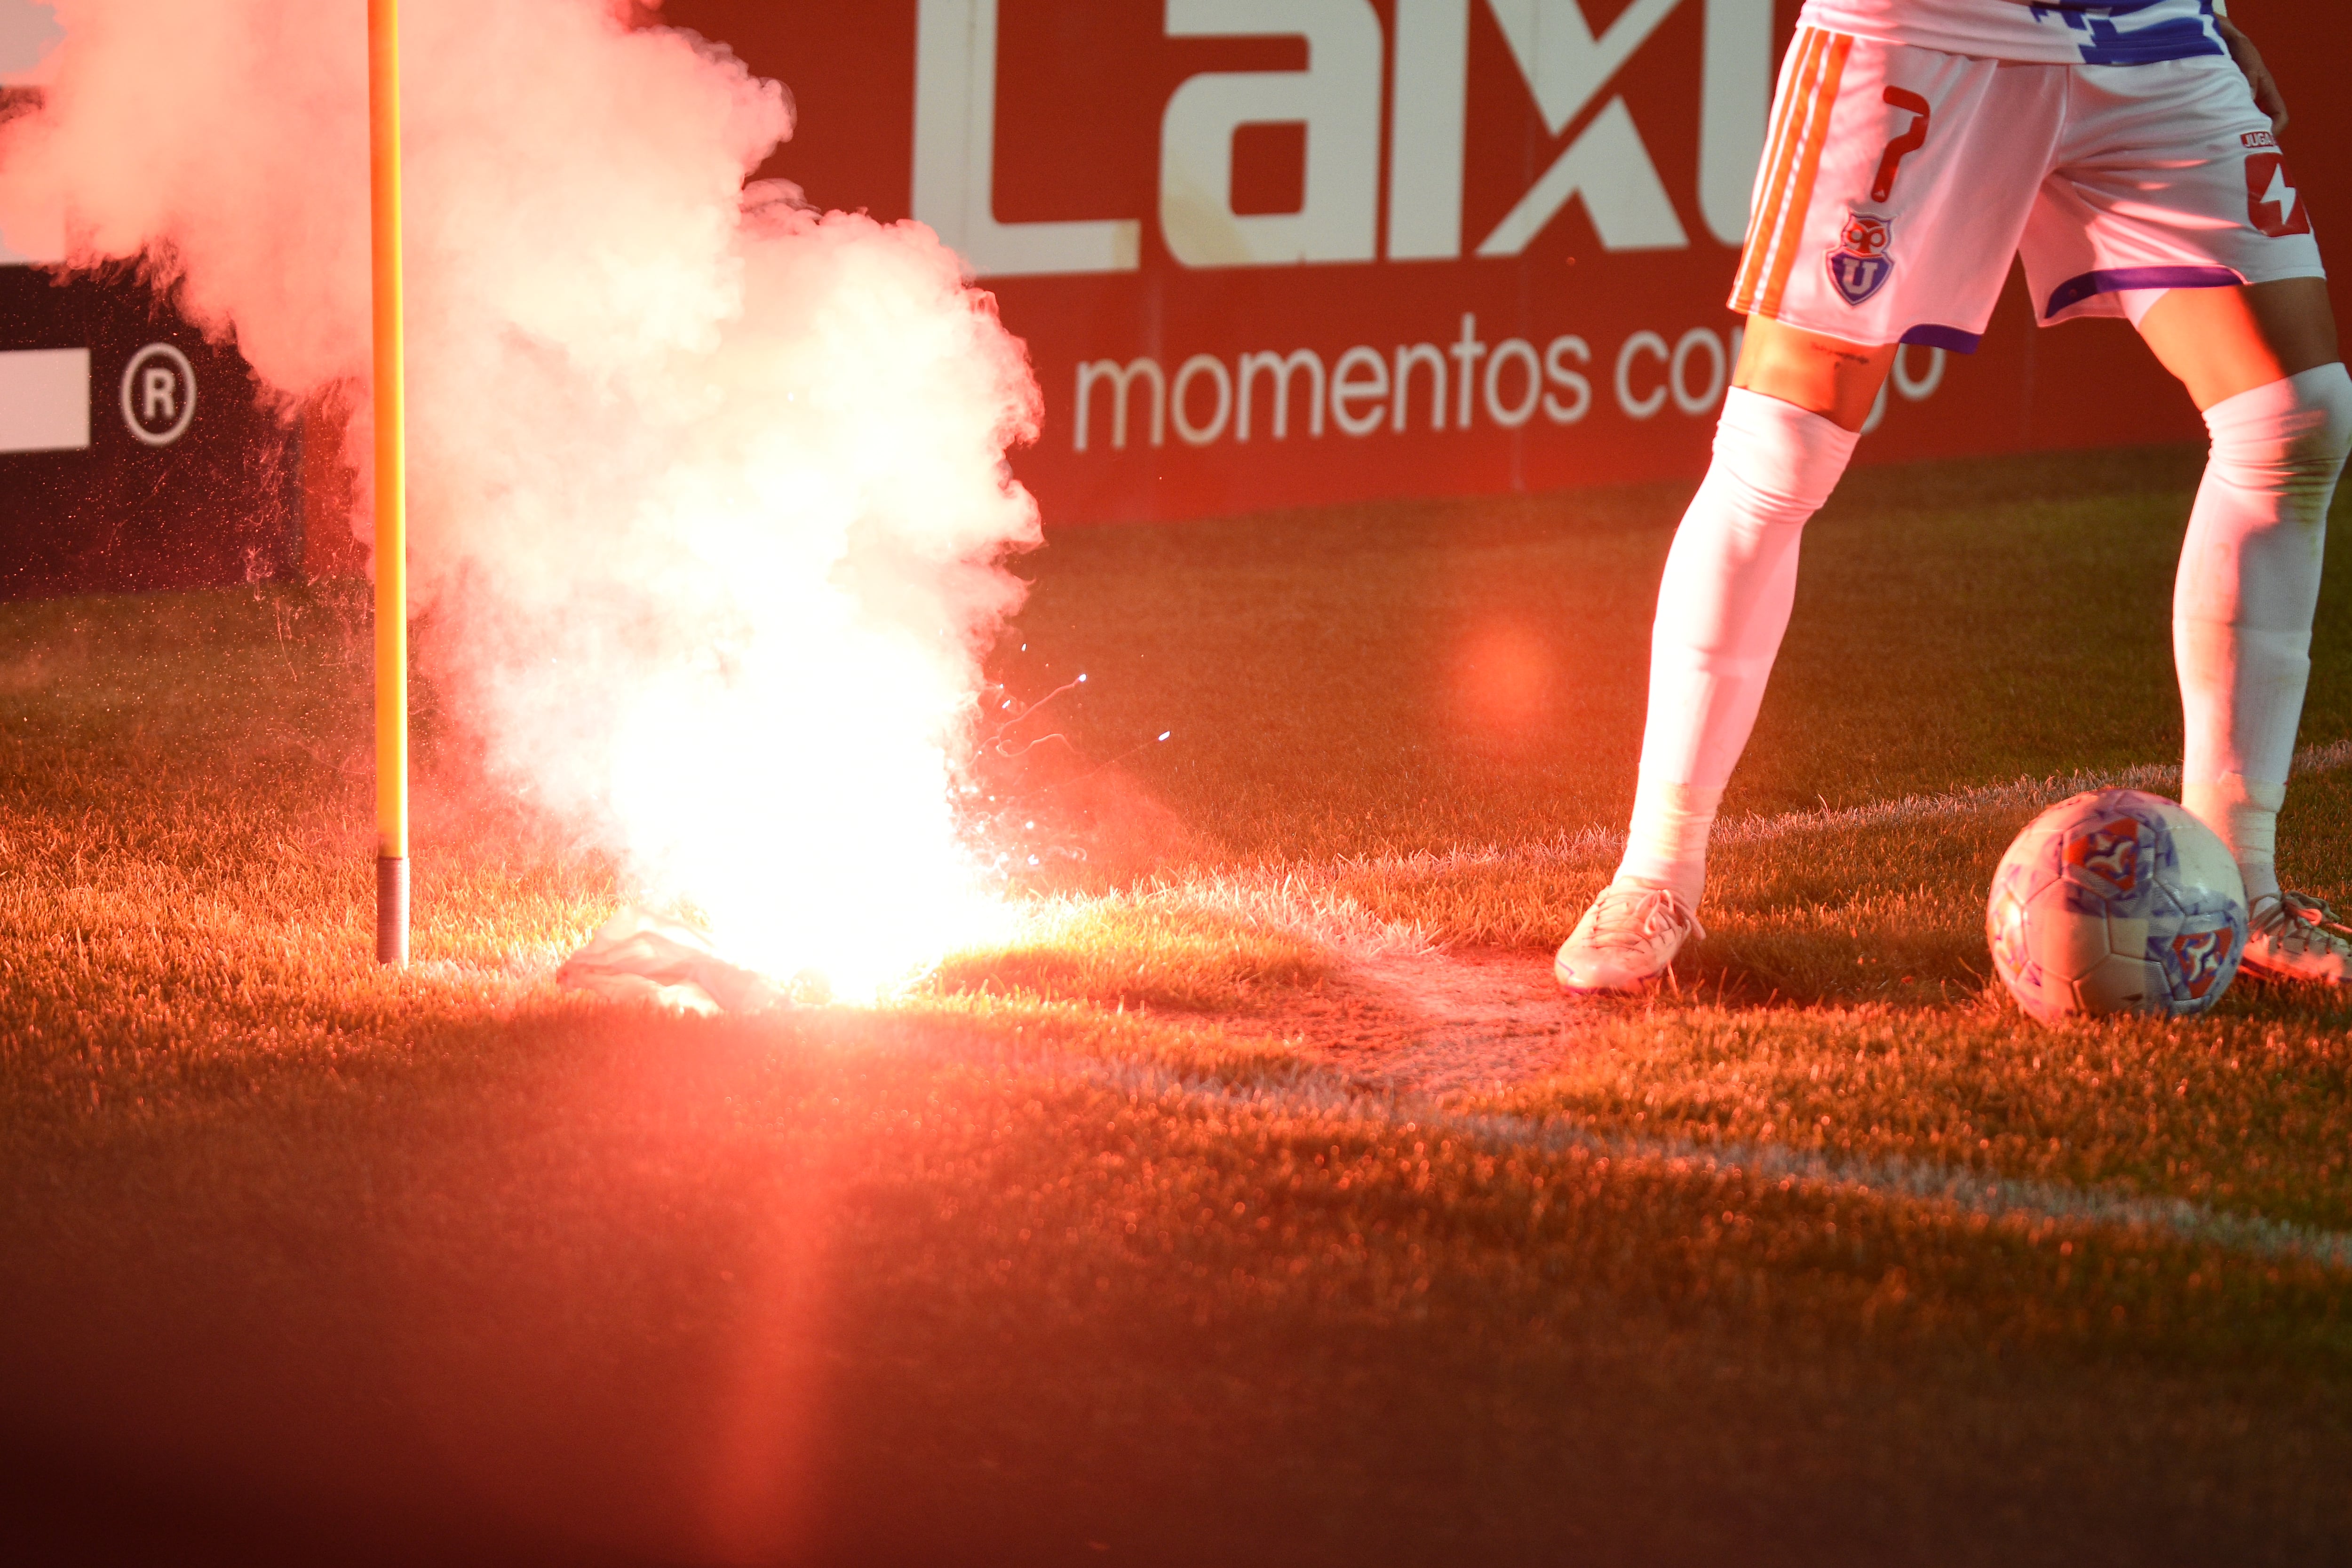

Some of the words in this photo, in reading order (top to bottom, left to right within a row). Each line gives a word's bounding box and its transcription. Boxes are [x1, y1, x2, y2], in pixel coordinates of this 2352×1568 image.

[1871, 86, 1930, 203] 7
[1842, 259, 1878, 295] U
[1073, 312, 1592, 452] momentos
